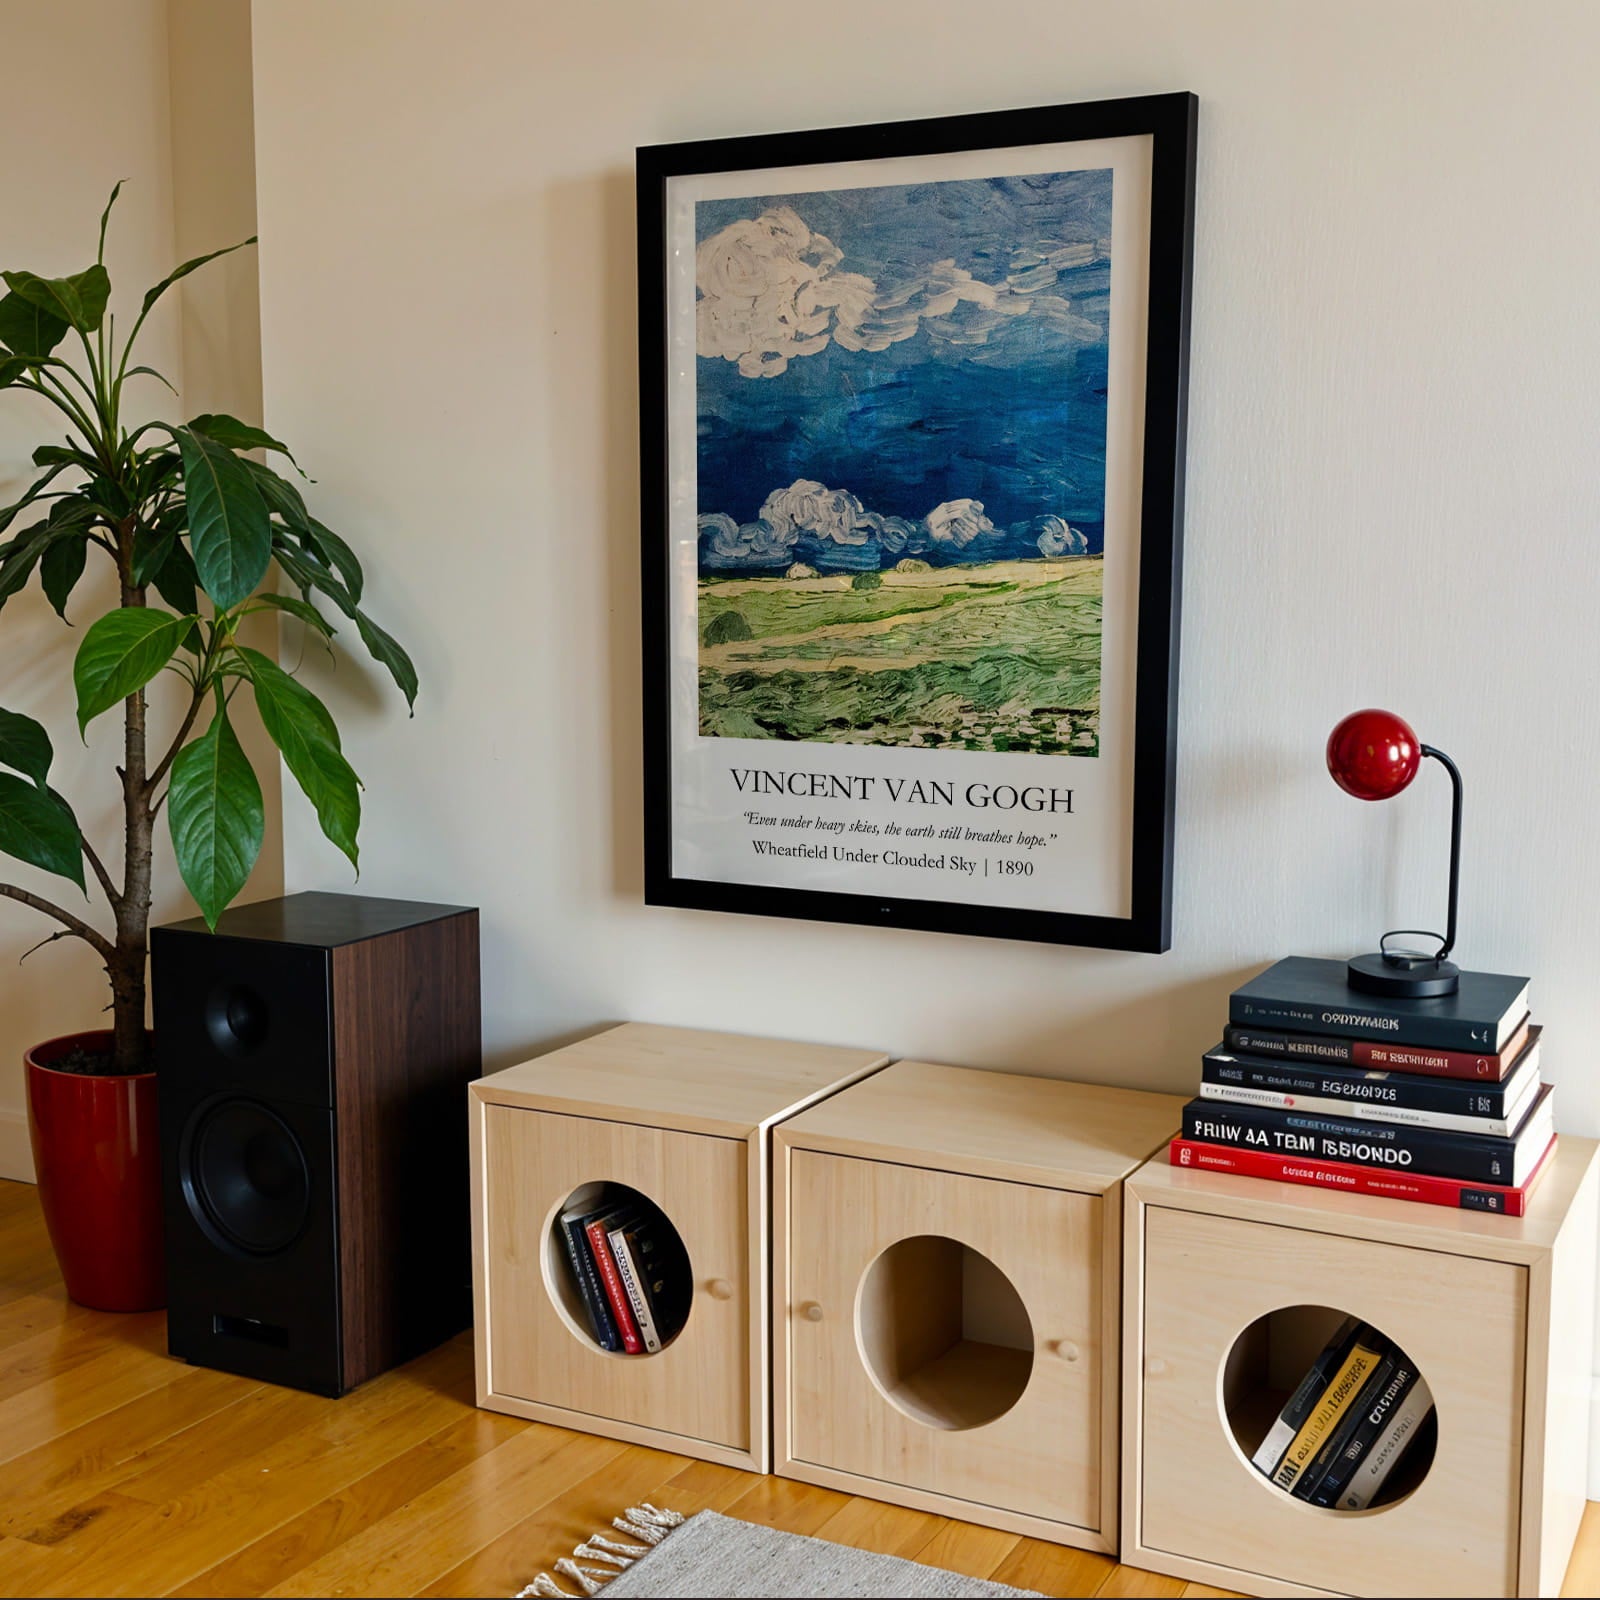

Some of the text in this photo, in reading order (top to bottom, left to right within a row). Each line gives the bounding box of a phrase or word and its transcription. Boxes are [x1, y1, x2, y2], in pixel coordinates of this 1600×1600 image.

[729, 768, 1075, 814] VINCENT VAN GOGH
[780, 815, 813, 829] under
[814, 816, 846, 835] heavy
[848, 819, 880, 836] skies,
[884, 821, 902, 836] the
[905, 824, 935, 839] earth
[938, 826, 963, 840] still
[964, 829, 1013, 845] breathes
[752, 839, 828, 860] Wheatfield
[832, 846, 879, 864] Under
[882, 850, 945, 869] Clouded
[949, 855, 977, 876] Sky
[997, 859, 1034, 877] 1890
